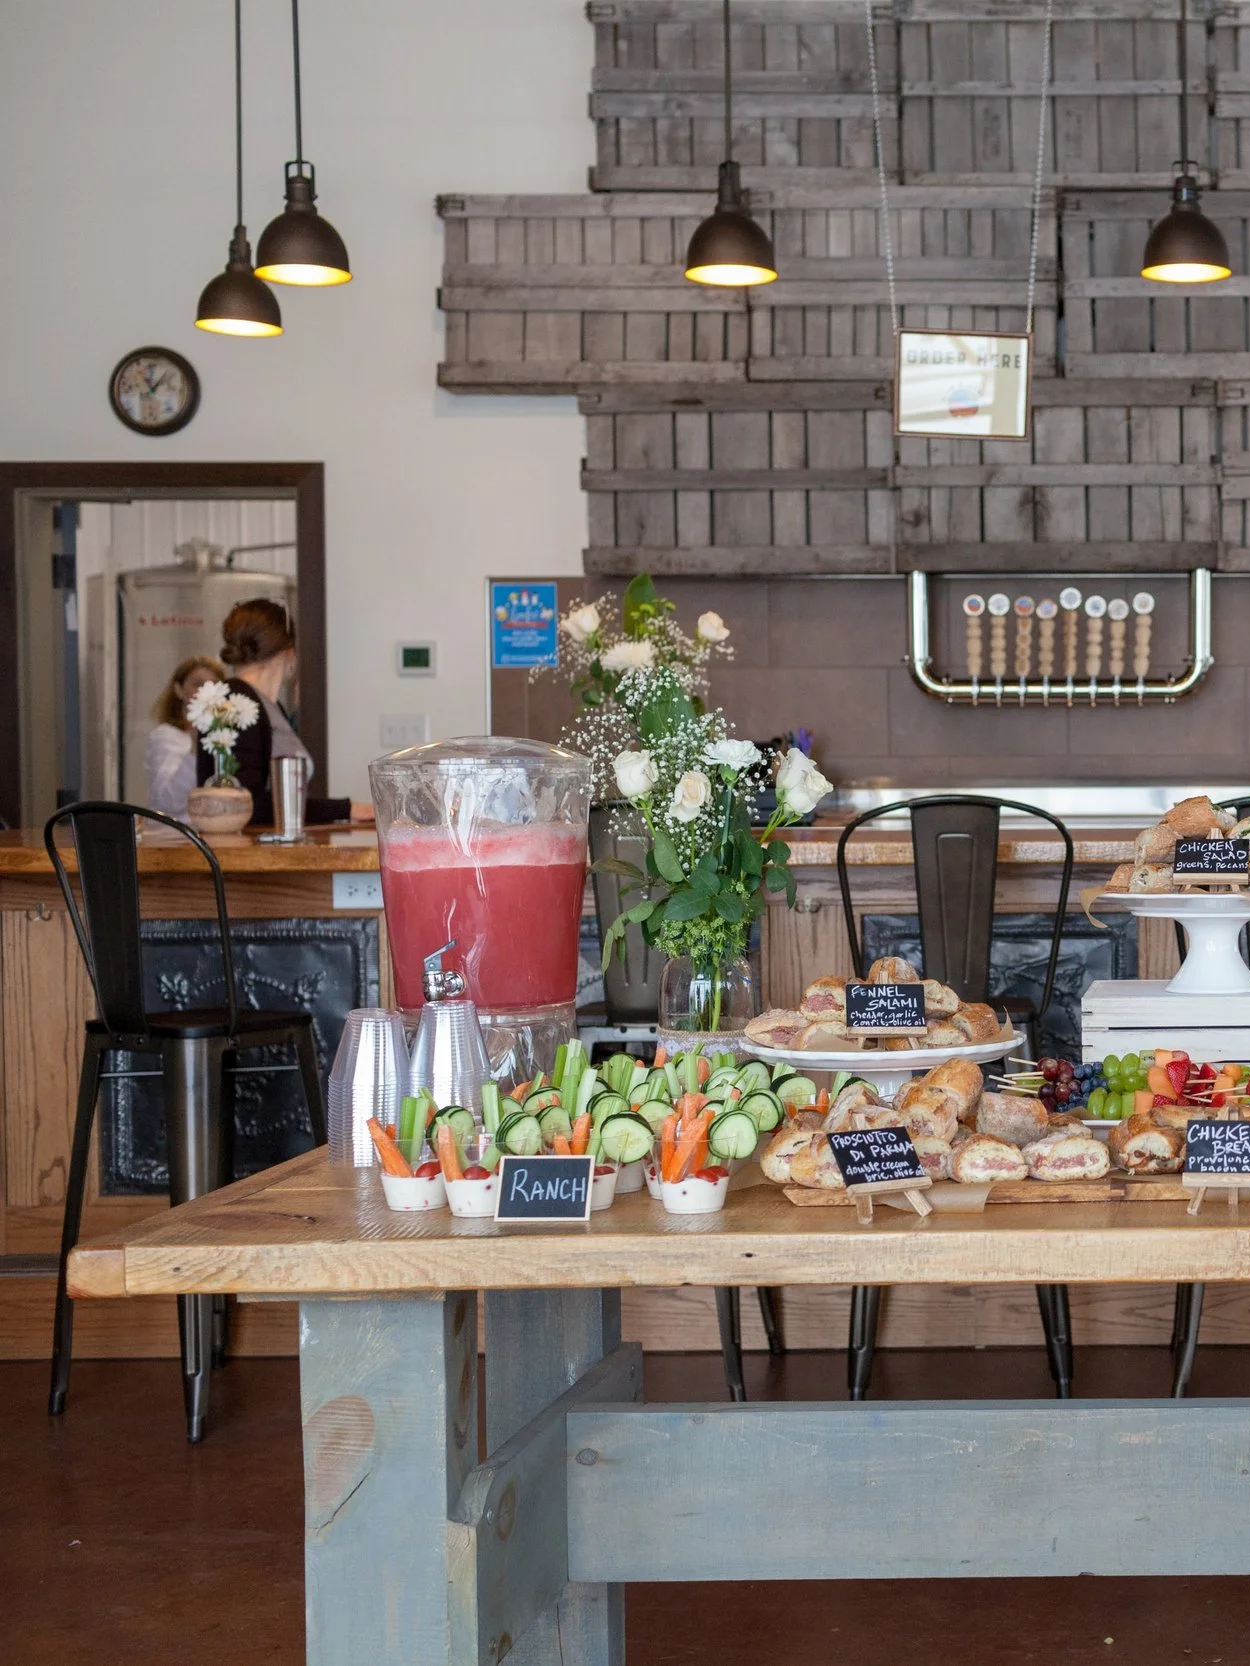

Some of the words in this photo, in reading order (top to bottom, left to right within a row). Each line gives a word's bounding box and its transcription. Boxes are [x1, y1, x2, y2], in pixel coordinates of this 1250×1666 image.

[905, 349, 967, 365] ORDER
[976, 353, 1022, 369] HERE
[1203, 850, 1247, 861] SALAD
[1176, 860, 1212, 871] greens,
[1215, 861, 1249, 872] pecans
[851, 985, 906, 998] FENNEL
[865, 997, 918, 1011] SALAMI
[888, 1009, 918, 1023] garlic
[914, 1017, 926, 1026] oil
[831, 1131, 897, 1149] PROSCIUTTO
[849, 1150, 865, 1161] DI
[870, 1141, 914, 1158] PARMA
[845, 1161, 880, 1175] double
[881, 1160, 909, 1170] cream
[894, 1168, 914, 1178] olive
[1200, 1162, 1237, 1172] bacon
[510, 1168, 586, 1202] RANCH
